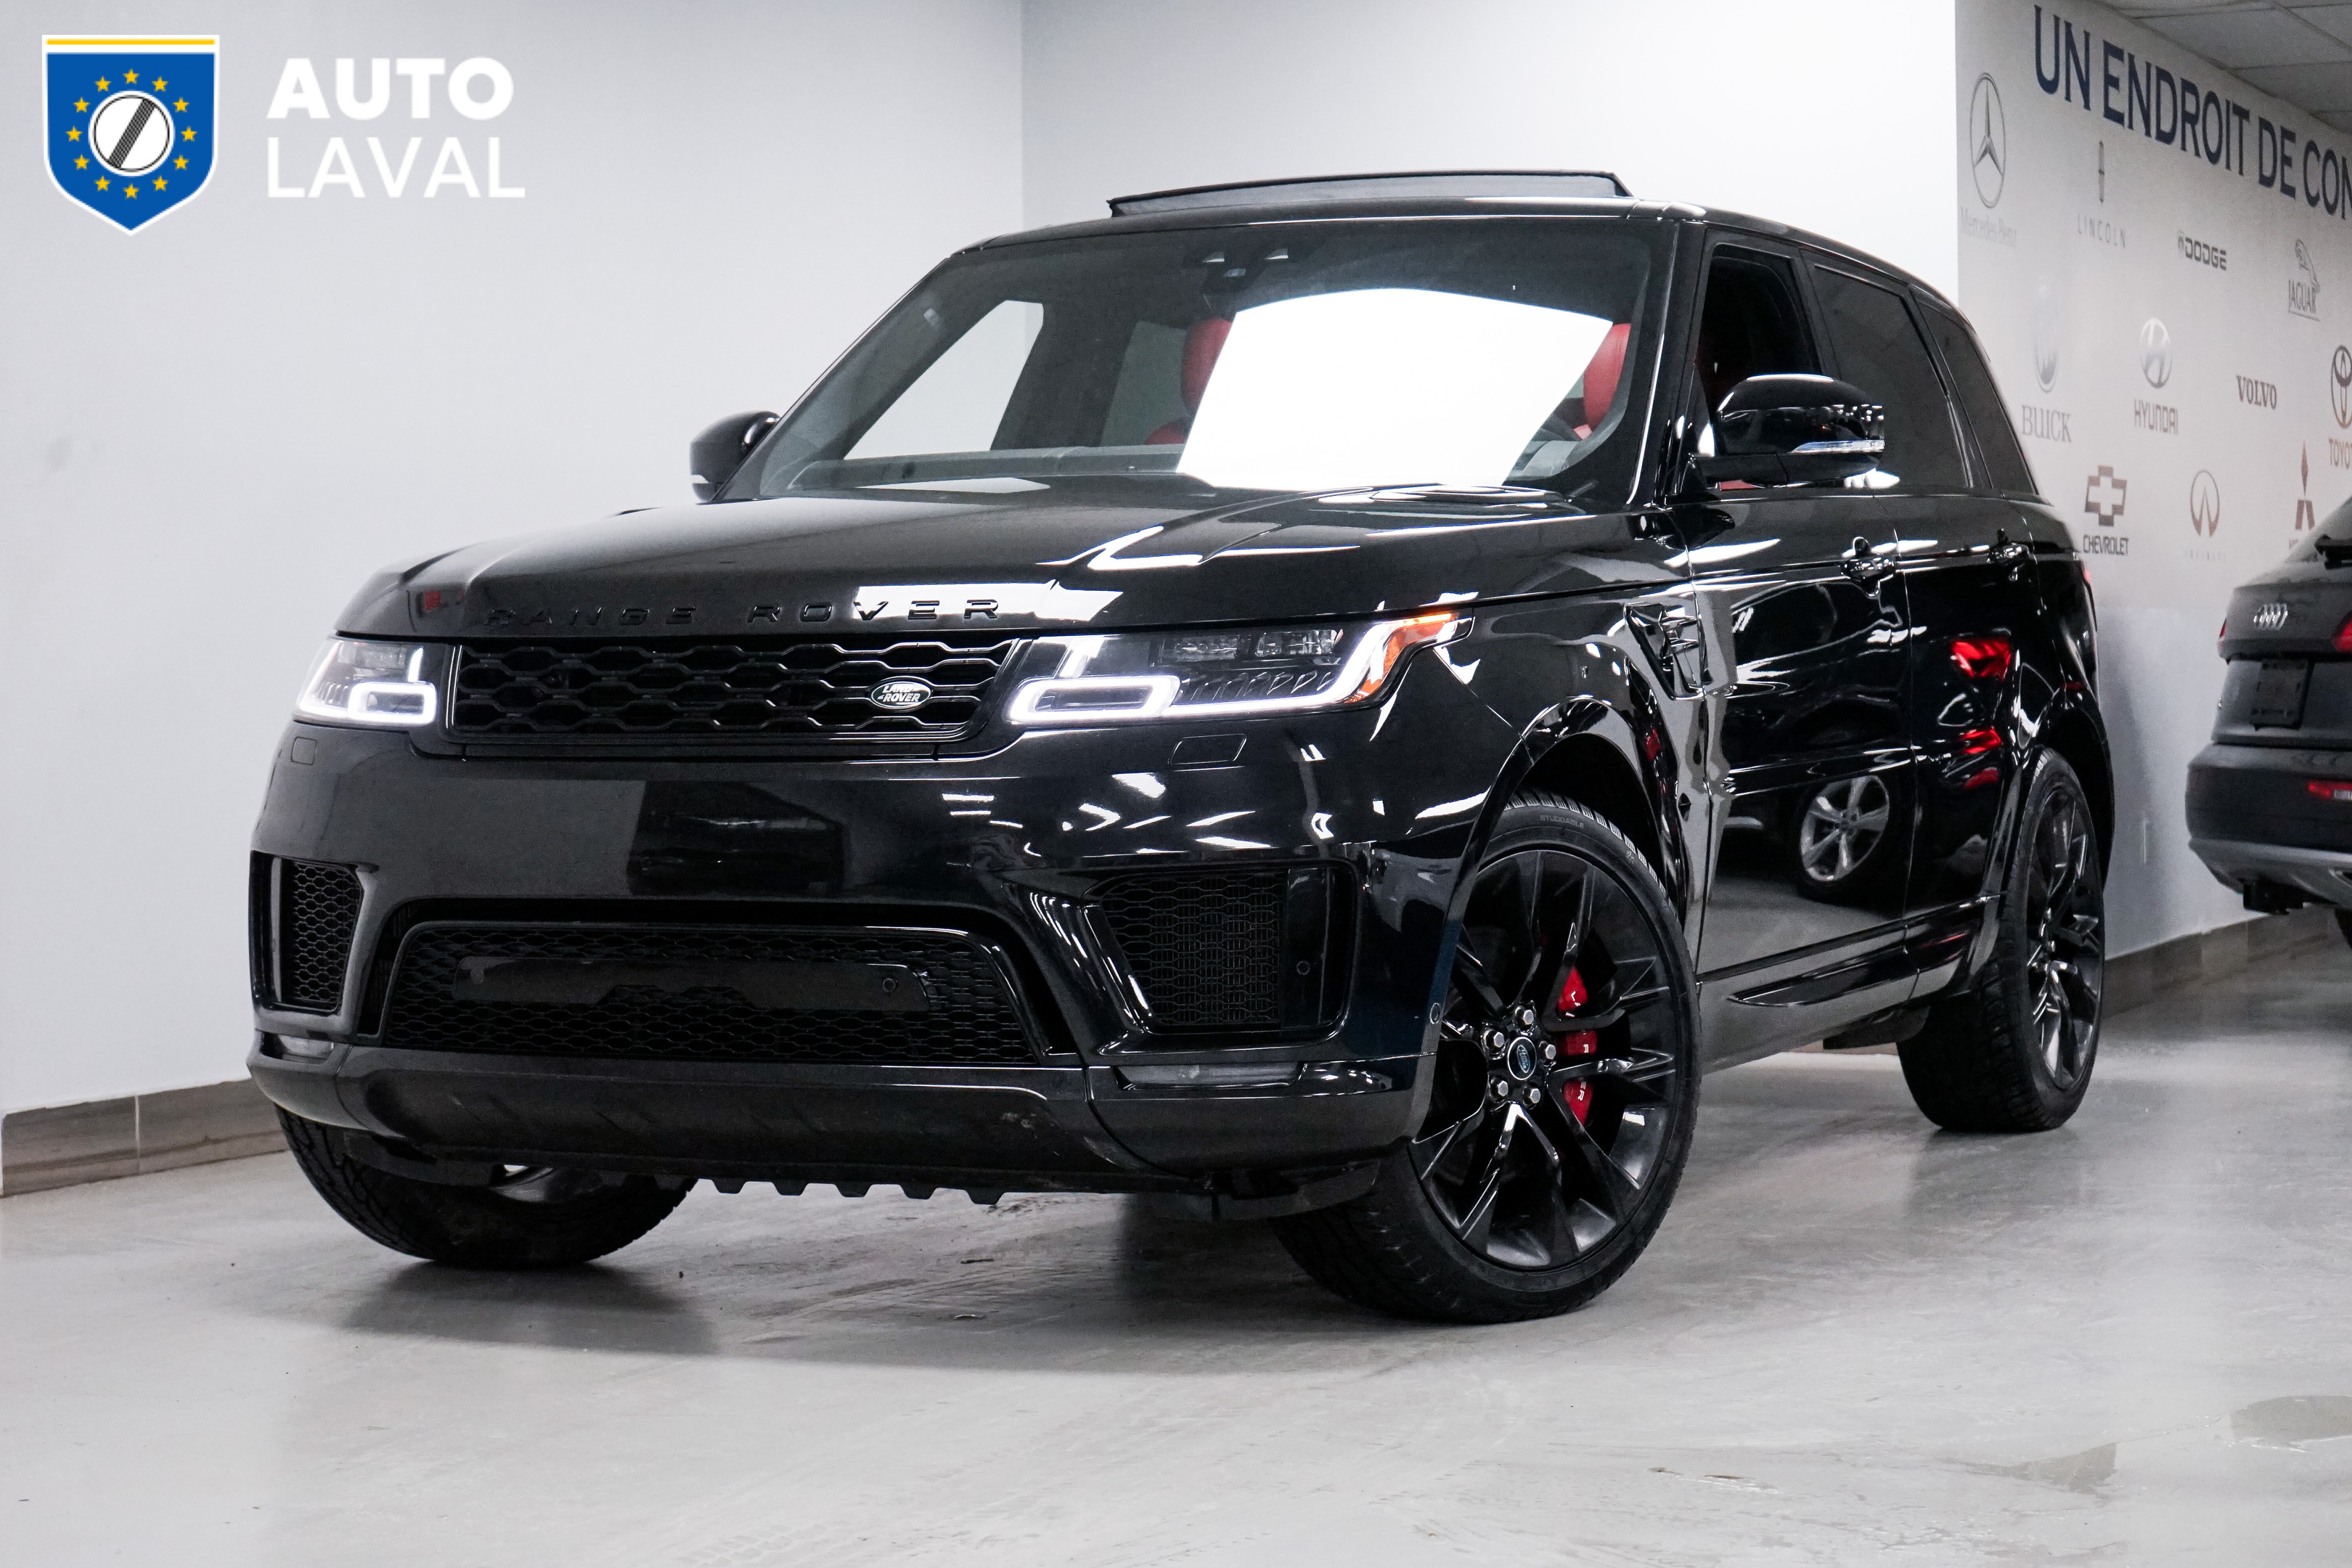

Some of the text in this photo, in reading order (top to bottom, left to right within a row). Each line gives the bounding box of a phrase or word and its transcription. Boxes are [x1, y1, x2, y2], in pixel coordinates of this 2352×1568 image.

[2034, 4, 2091, 111] UN
[2102, 39, 2251, 176] ENDROIT
[2258, 116, 2296, 200] DE
[2077, 213, 2126, 248] LINCOLN
[2185, 237, 2227, 271] DODGE
[2287, 279, 2316, 314] JAGUAR
[2236, 375, 2278, 410] VOLVO
[2021, 404, 2073, 444] BUICK
[2133, 399, 2179, 436] HYUNDAI
[2328, 437, 2352, 470] TOYO
[2083, 534, 2129, 556] CHEVROLET
[482, 597, 1000, 626] RANGE ROVER
[883, 684, 915, 693] LAND
[883, 693, 920, 702] ROVER
